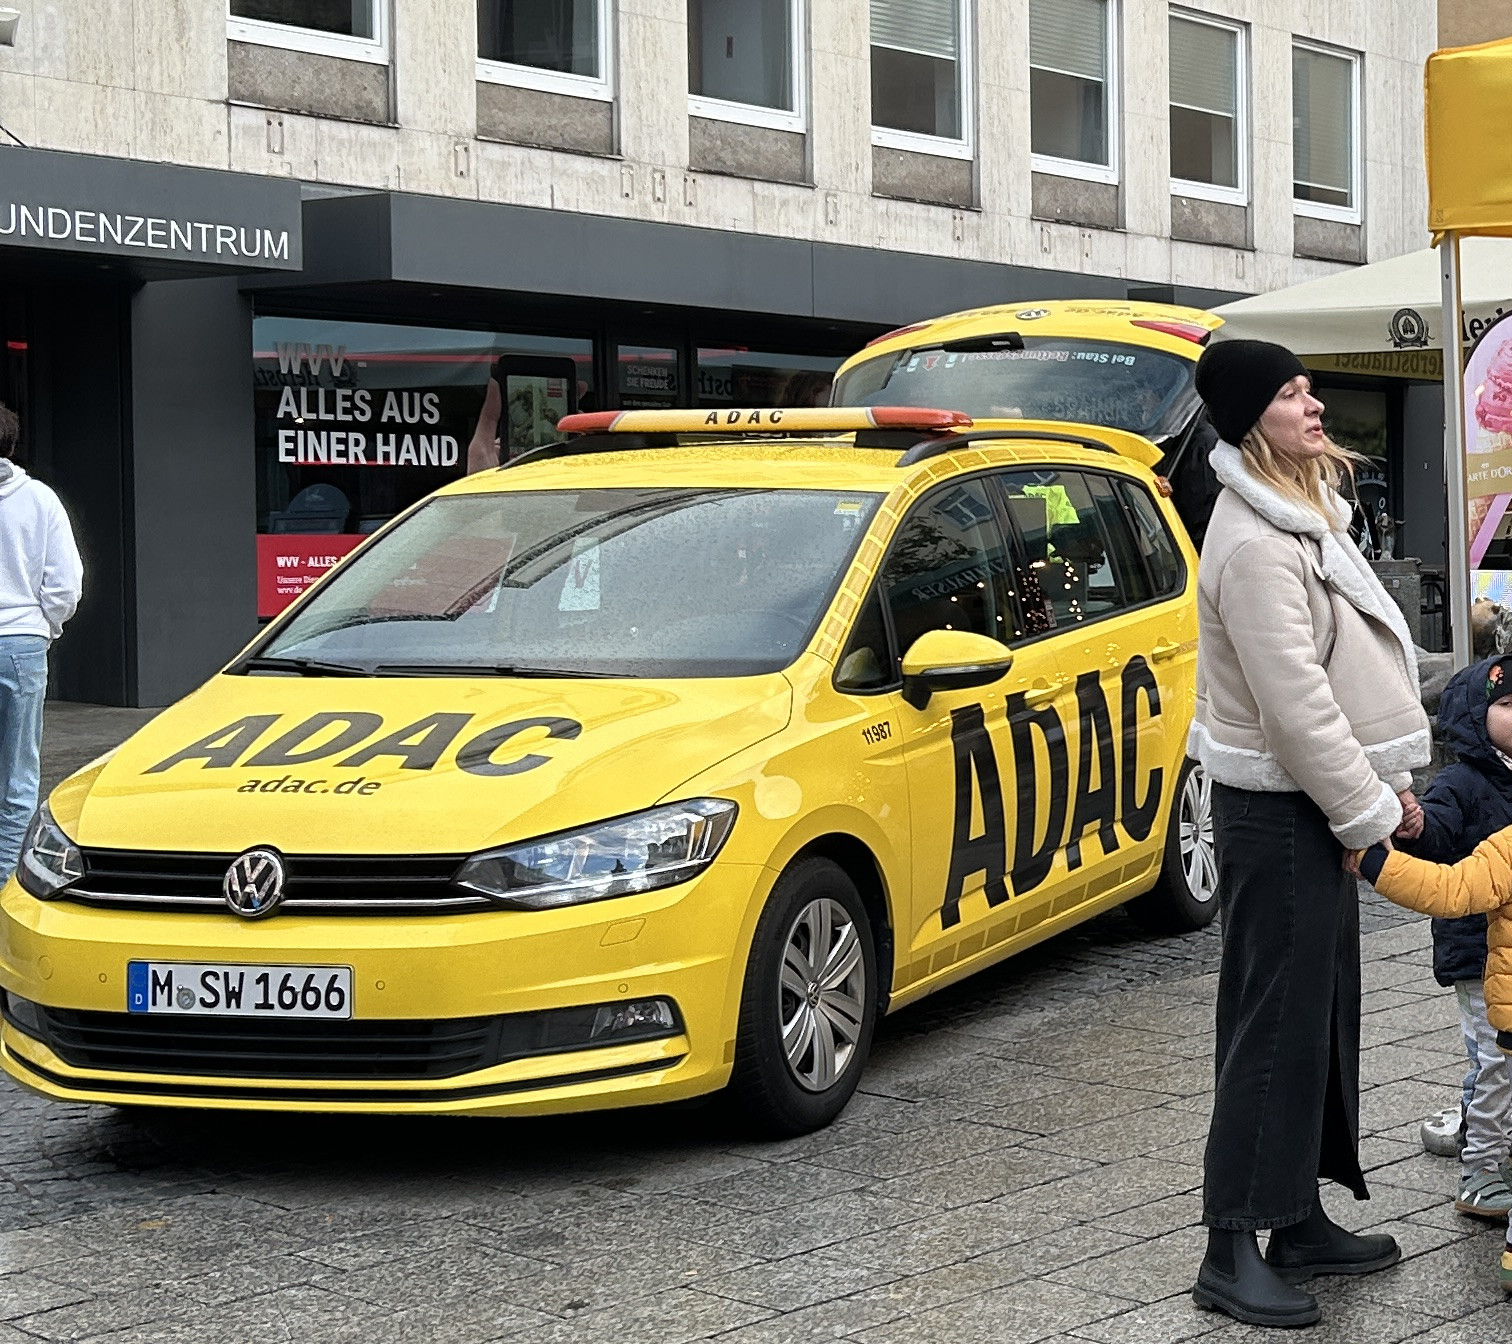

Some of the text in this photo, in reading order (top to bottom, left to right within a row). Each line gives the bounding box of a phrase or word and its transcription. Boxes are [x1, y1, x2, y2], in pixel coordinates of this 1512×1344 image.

[0, 203, 290, 260] UNDENZENTRUM
[276, 341, 347, 377] WVV
[276, 386, 440, 425] ALLES AUS
[704, 410, 784, 425] ADAC
[278, 429, 459, 467] EINER HAND
[276, 556, 300, 568] WVV
[139, 711, 583, 777] ADAC
[862, 720, 892, 745] 11987
[236, 775, 382, 797] adac.de
[941, 655, 1163, 930] ADAC
[254, 972, 346, 1012] 1666
